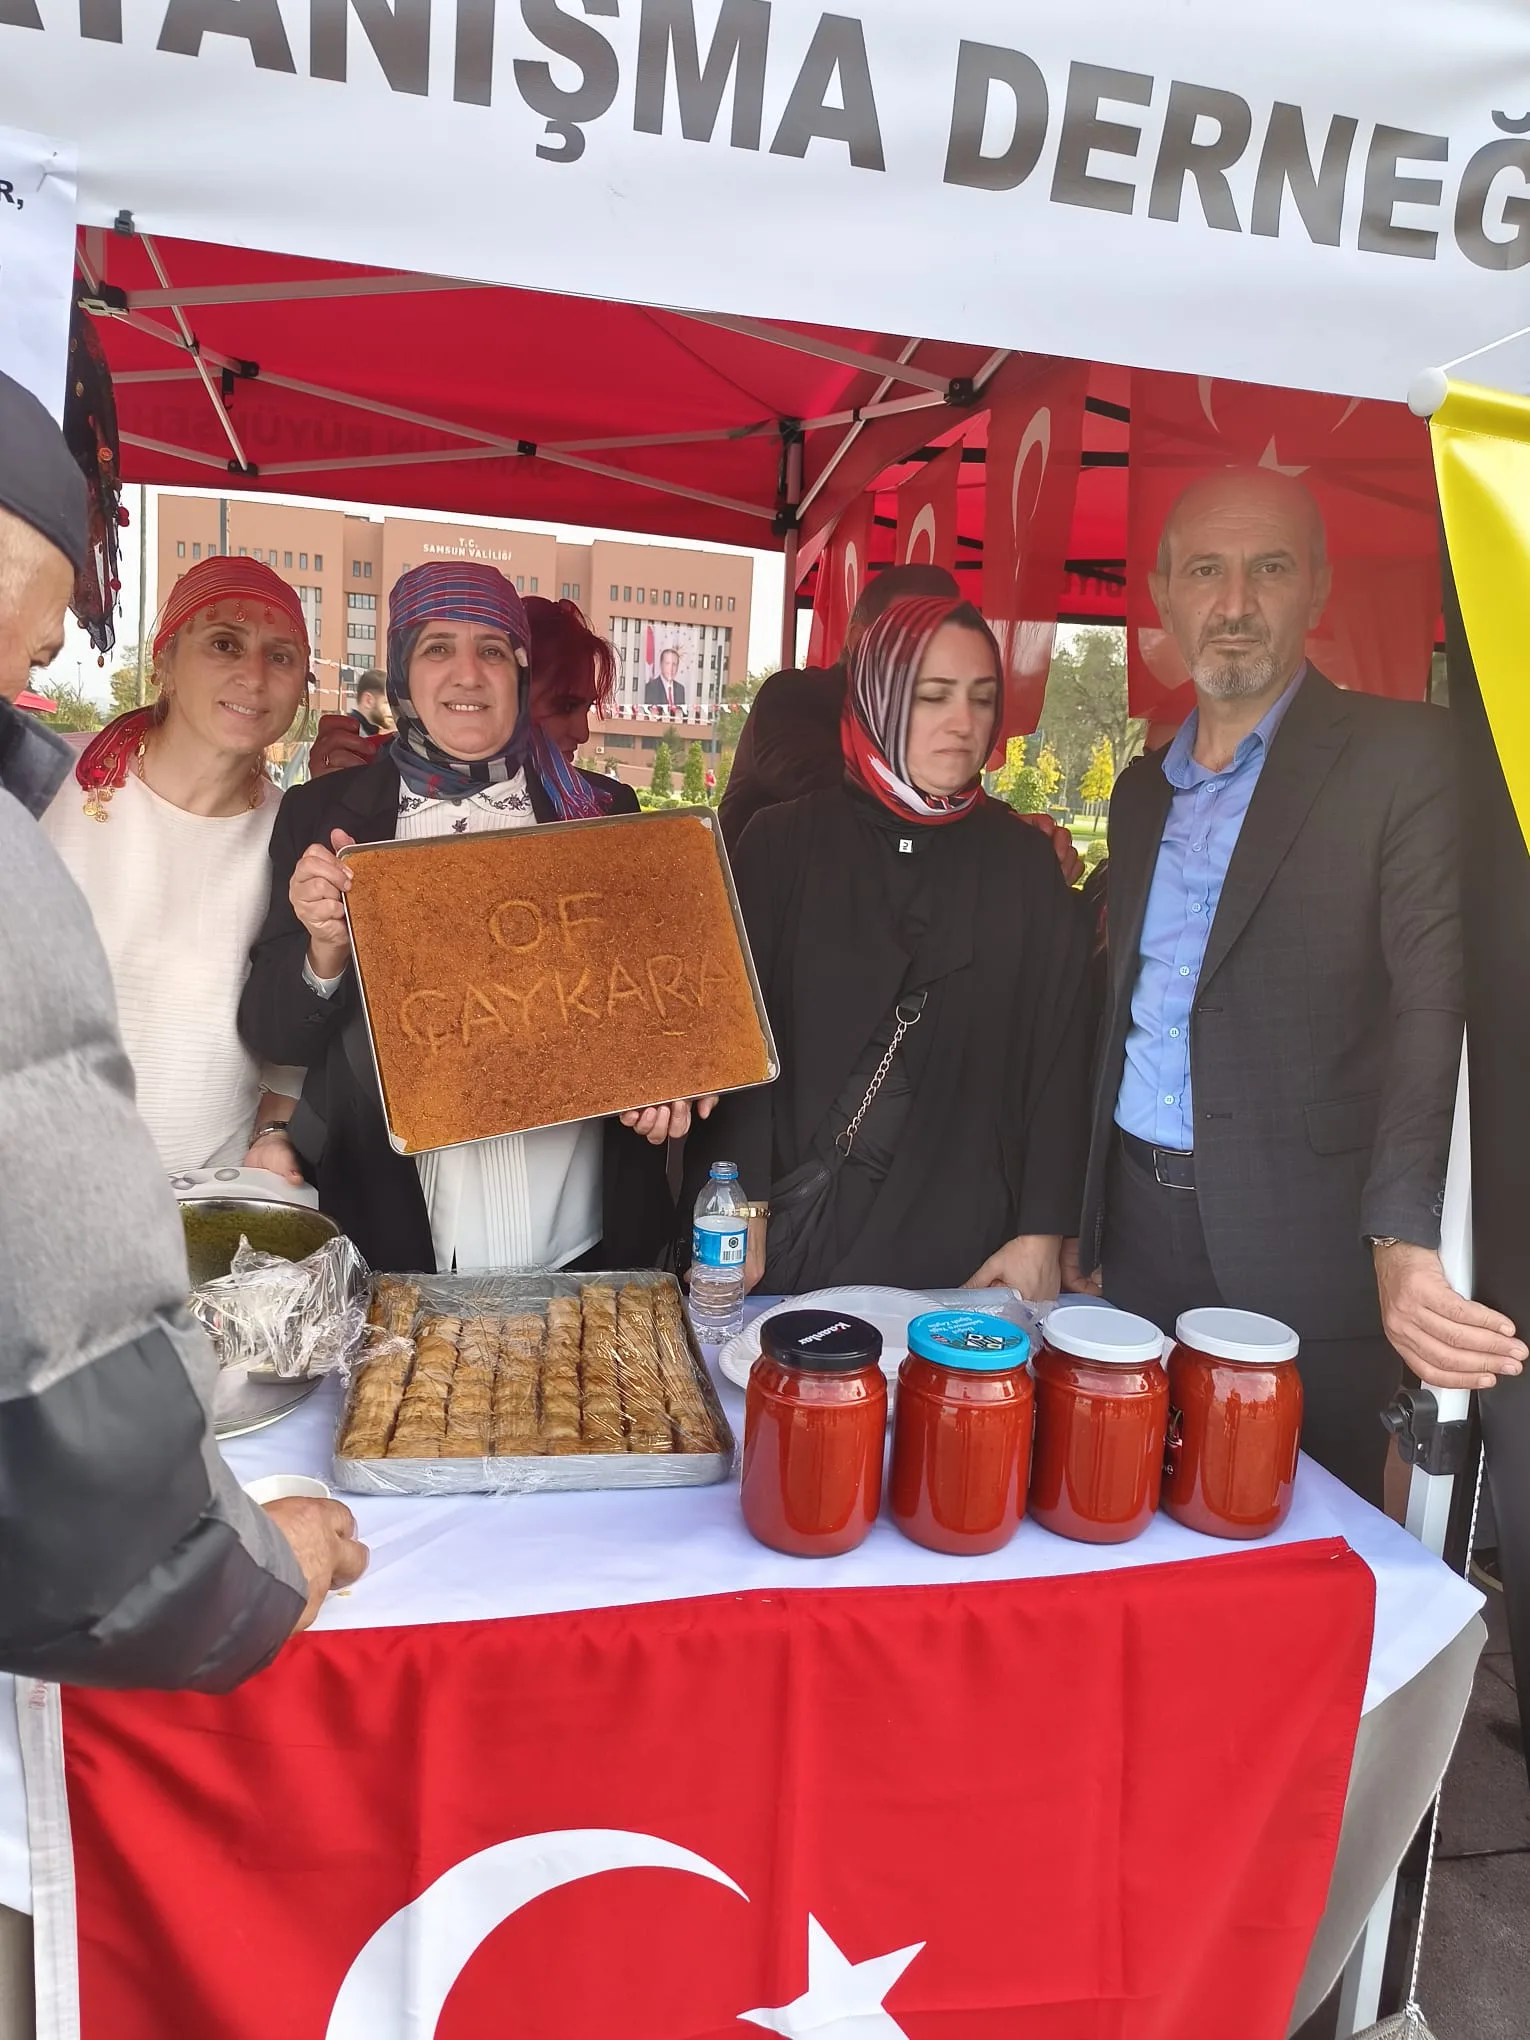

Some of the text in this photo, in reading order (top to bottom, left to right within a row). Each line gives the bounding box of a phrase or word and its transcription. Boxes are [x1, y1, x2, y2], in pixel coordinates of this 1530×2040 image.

[459, 538, 478, 549] T.C.
[423, 544, 465, 556] SAMSUN
[488, 891, 604, 954] OF
